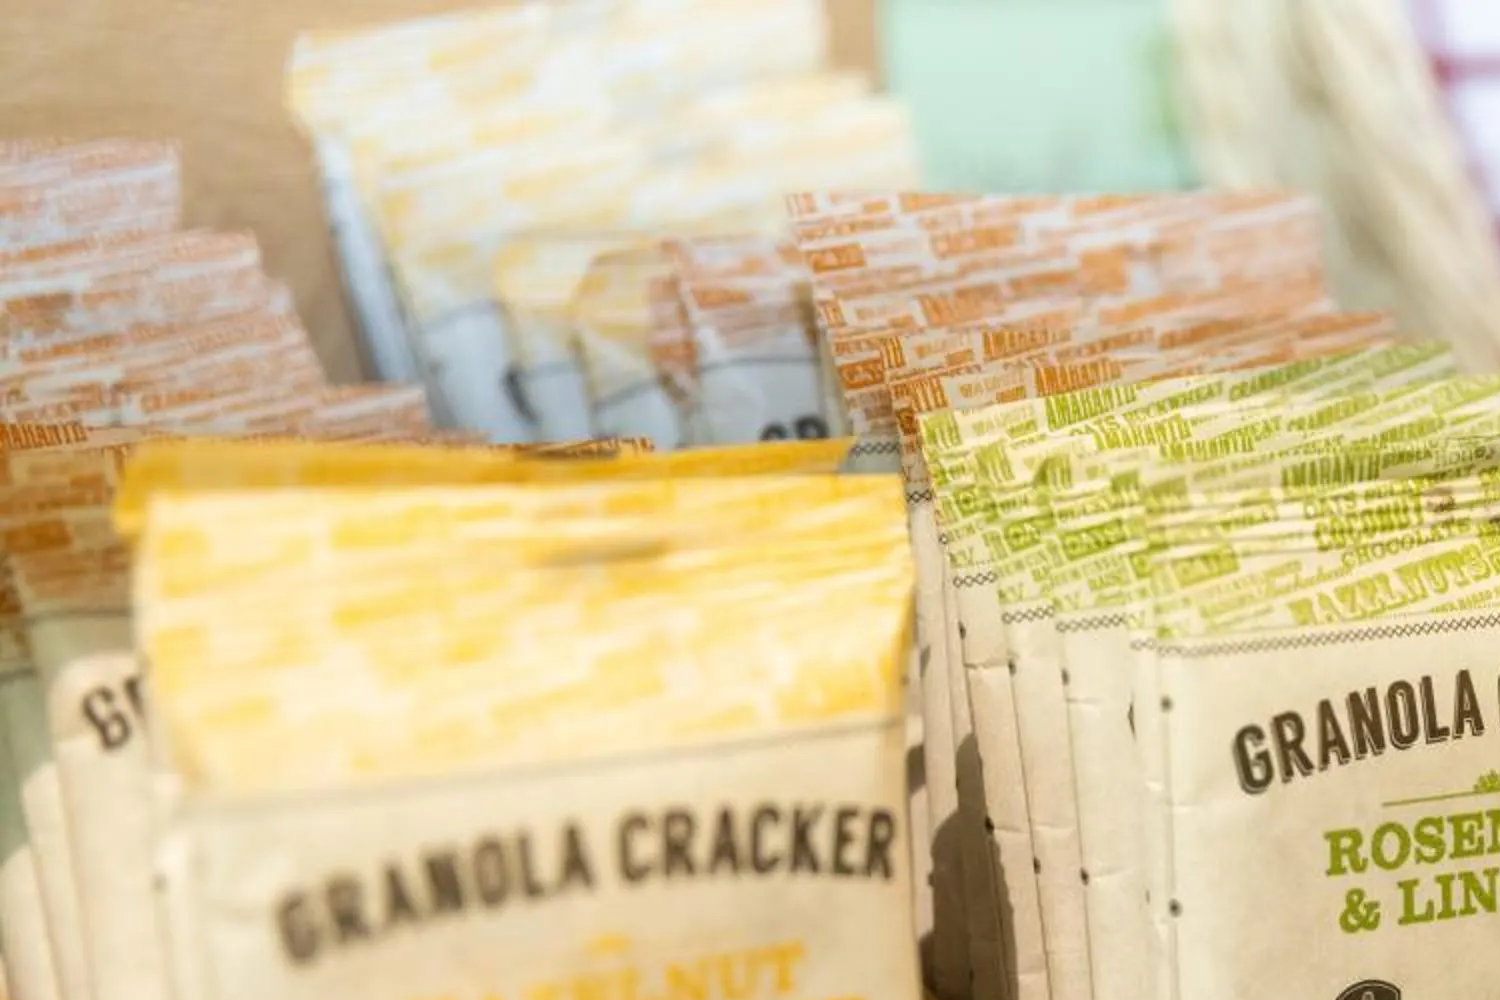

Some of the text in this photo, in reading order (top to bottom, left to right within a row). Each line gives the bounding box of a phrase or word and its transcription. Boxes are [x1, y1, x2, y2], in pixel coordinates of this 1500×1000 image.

[1232, 668, 1485, 796] GRANOLA
[276, 803, 899, 967] GRANOLA CRACKER
[1338, 888, 1382, 934] &
